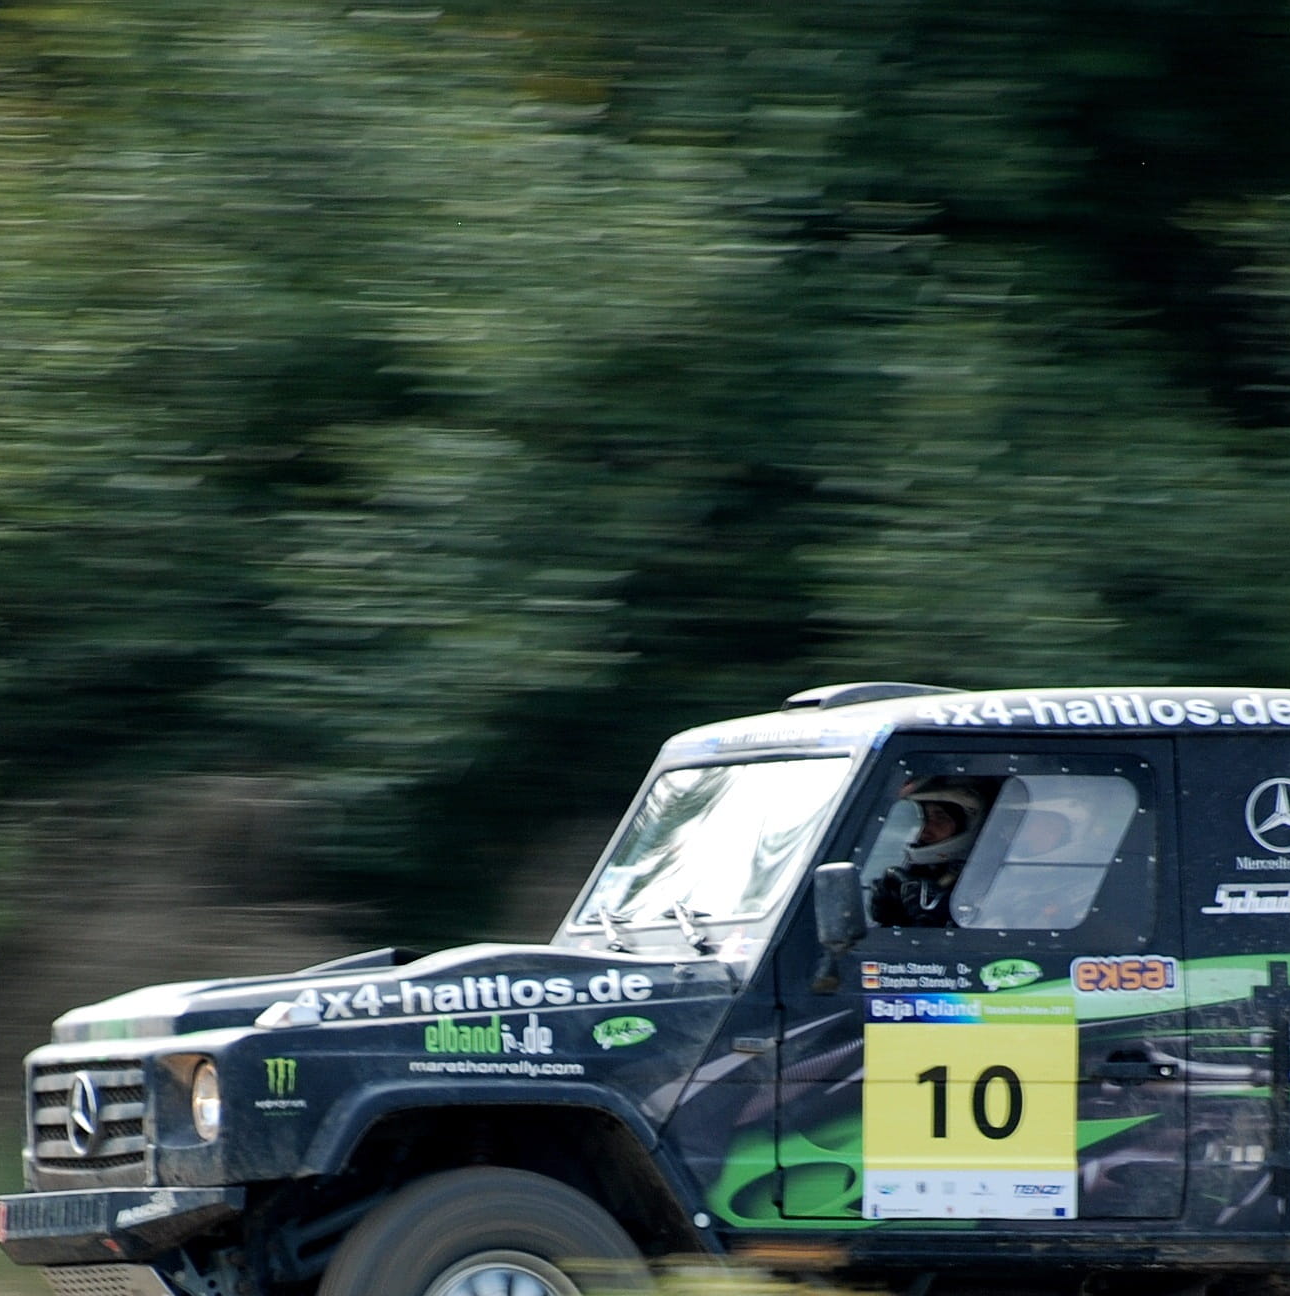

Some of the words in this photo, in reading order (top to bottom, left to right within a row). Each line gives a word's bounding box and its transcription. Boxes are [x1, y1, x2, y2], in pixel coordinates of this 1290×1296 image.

[872, 1000, 914, 1020] Baja
[916, 1000, 981, 1017] Poland
[409, 1060, 585, 1077] marathonrally.com
[916, 1065, 1023, 1140] 10
